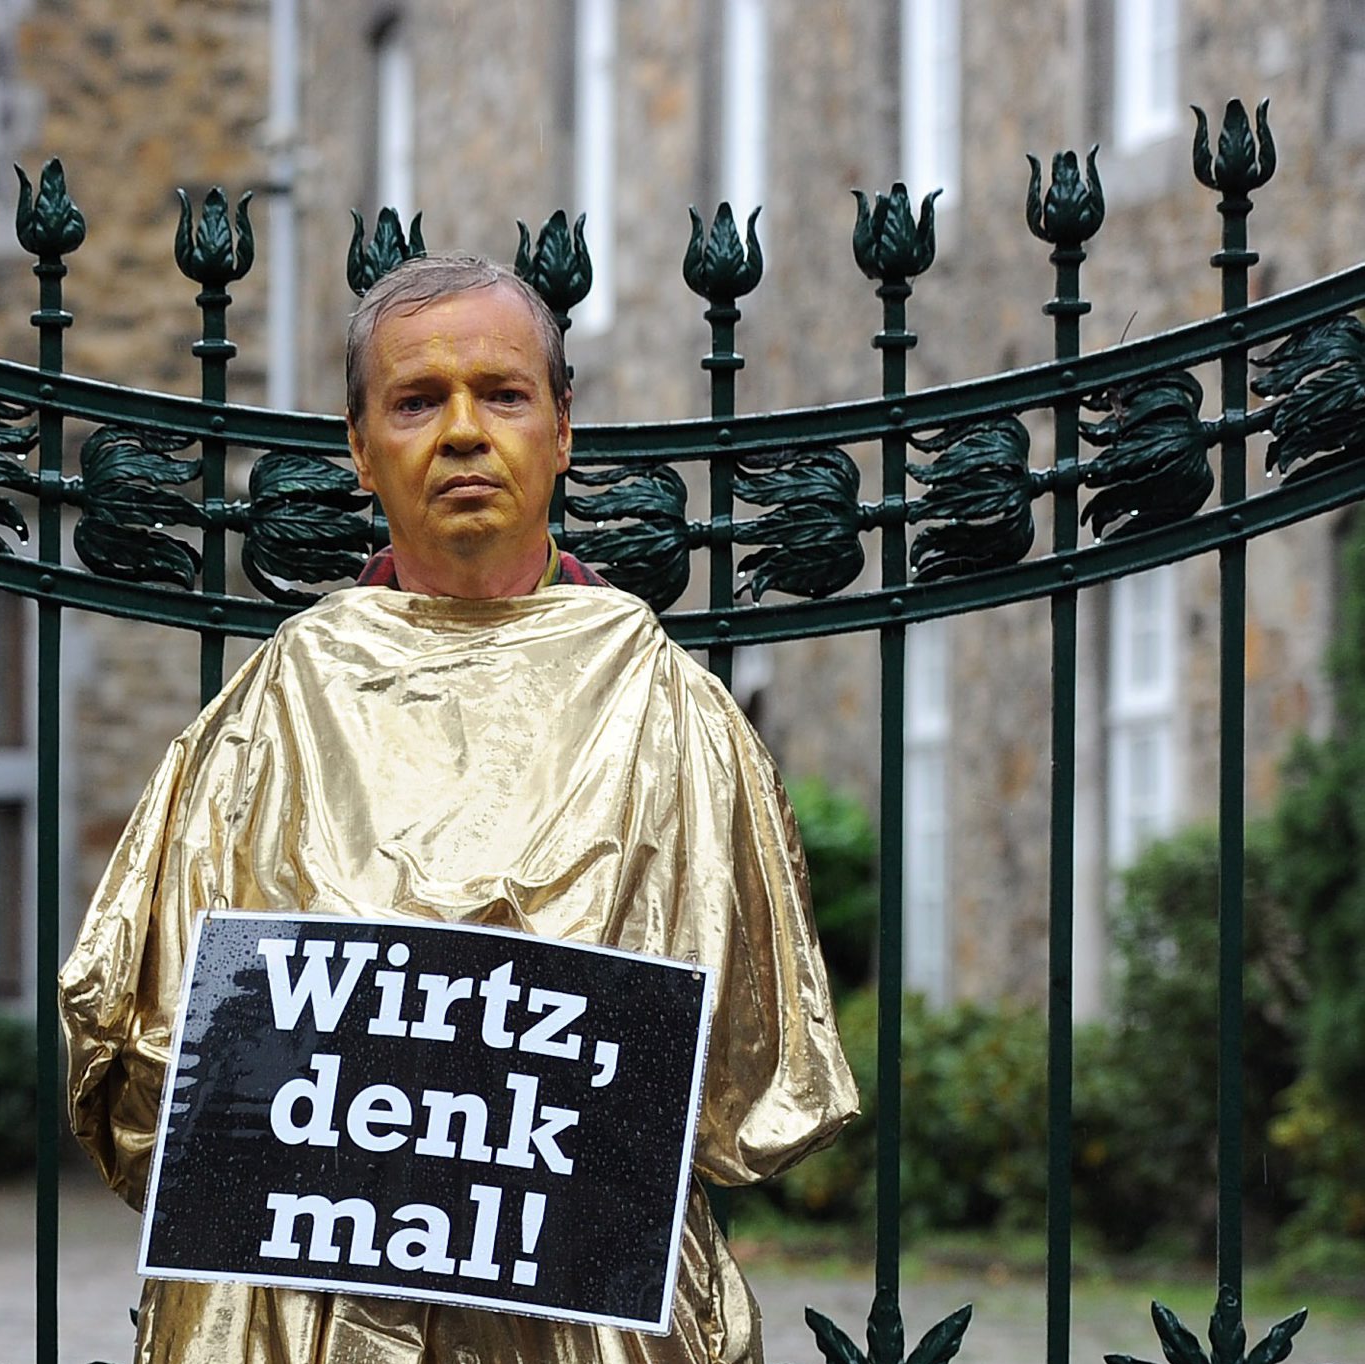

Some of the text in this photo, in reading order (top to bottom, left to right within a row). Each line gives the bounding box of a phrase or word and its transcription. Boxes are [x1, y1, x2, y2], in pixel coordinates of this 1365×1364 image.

[257, 938, 620, 1088] Wirtz,
[270, 1052, 579, 1175] denk
[258, 1184, 547, 1287] mal!
